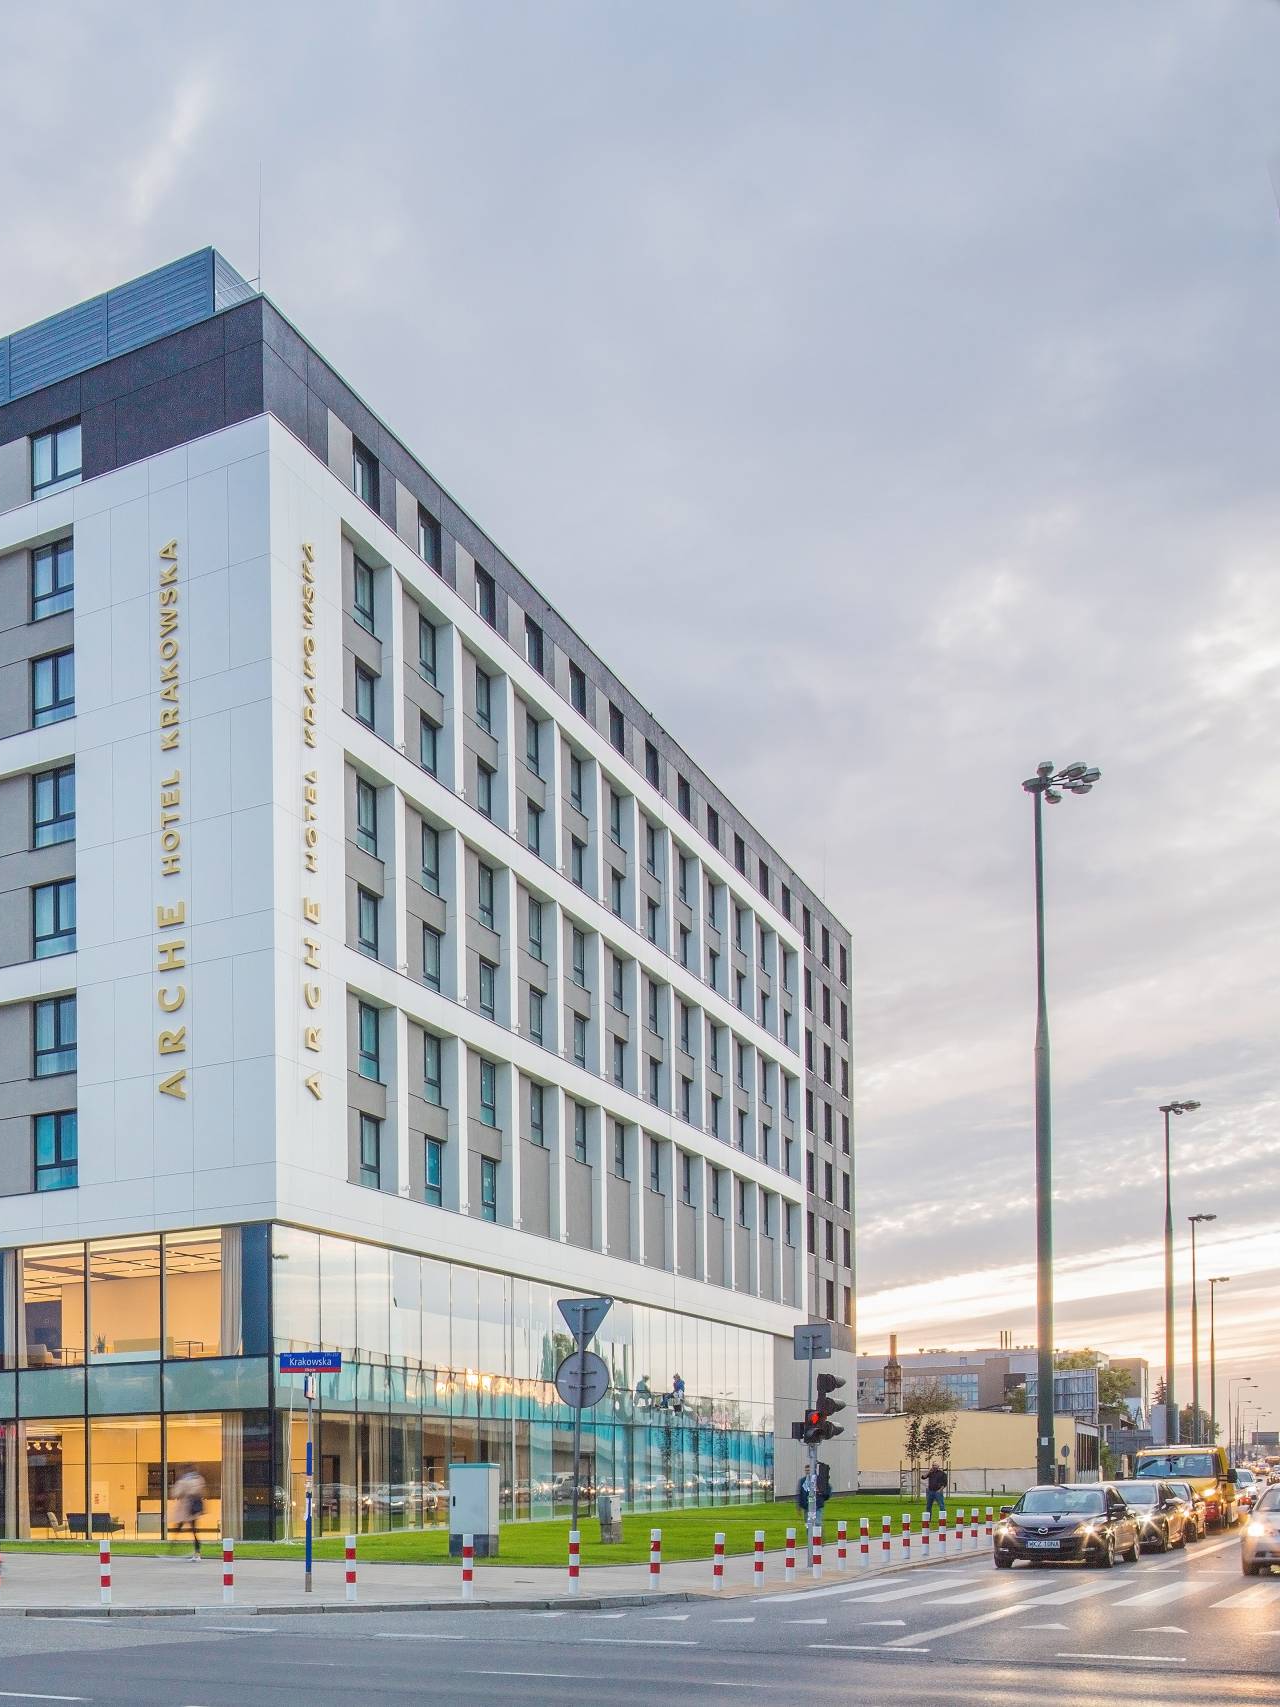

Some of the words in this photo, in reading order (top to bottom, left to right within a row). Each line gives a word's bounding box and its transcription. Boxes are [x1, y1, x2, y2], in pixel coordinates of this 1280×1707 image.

[159, 539, 181, 751] KRAKOWSKA
[302, 542, 317, 749] KRAKOWSKA
[160, 769, 181, 876] HOTEL
[304, 768, 318, 873] HOTEL
[157, 901, 186, 1100] ARCHE
[303, 896, 323, 1101] ARCHE
[289, 1356, 332, 1366] Krakowska
